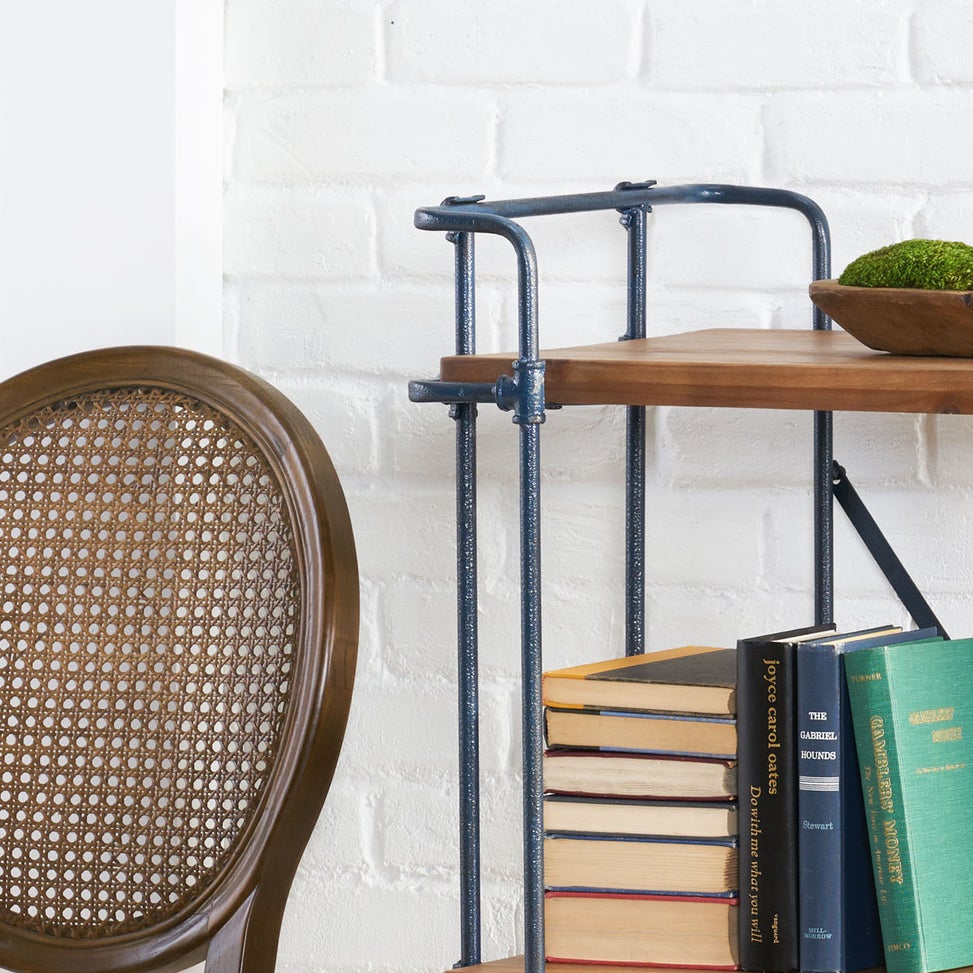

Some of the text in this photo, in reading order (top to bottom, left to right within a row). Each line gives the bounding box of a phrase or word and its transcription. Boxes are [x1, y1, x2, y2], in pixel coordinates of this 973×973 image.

[808, 711, 828, 721] THE
[763, 658, 781, 795] joyce carol oates
[800, 731, 838, 741] GABRIEL
[800, 750, 837, 760] HOUNDS
[870, 713, 904, 885] GAMBLERS' MONEY
[802, 820, 834, 831] Stewart
[748, 784, 763, 943] Do with me what you will
